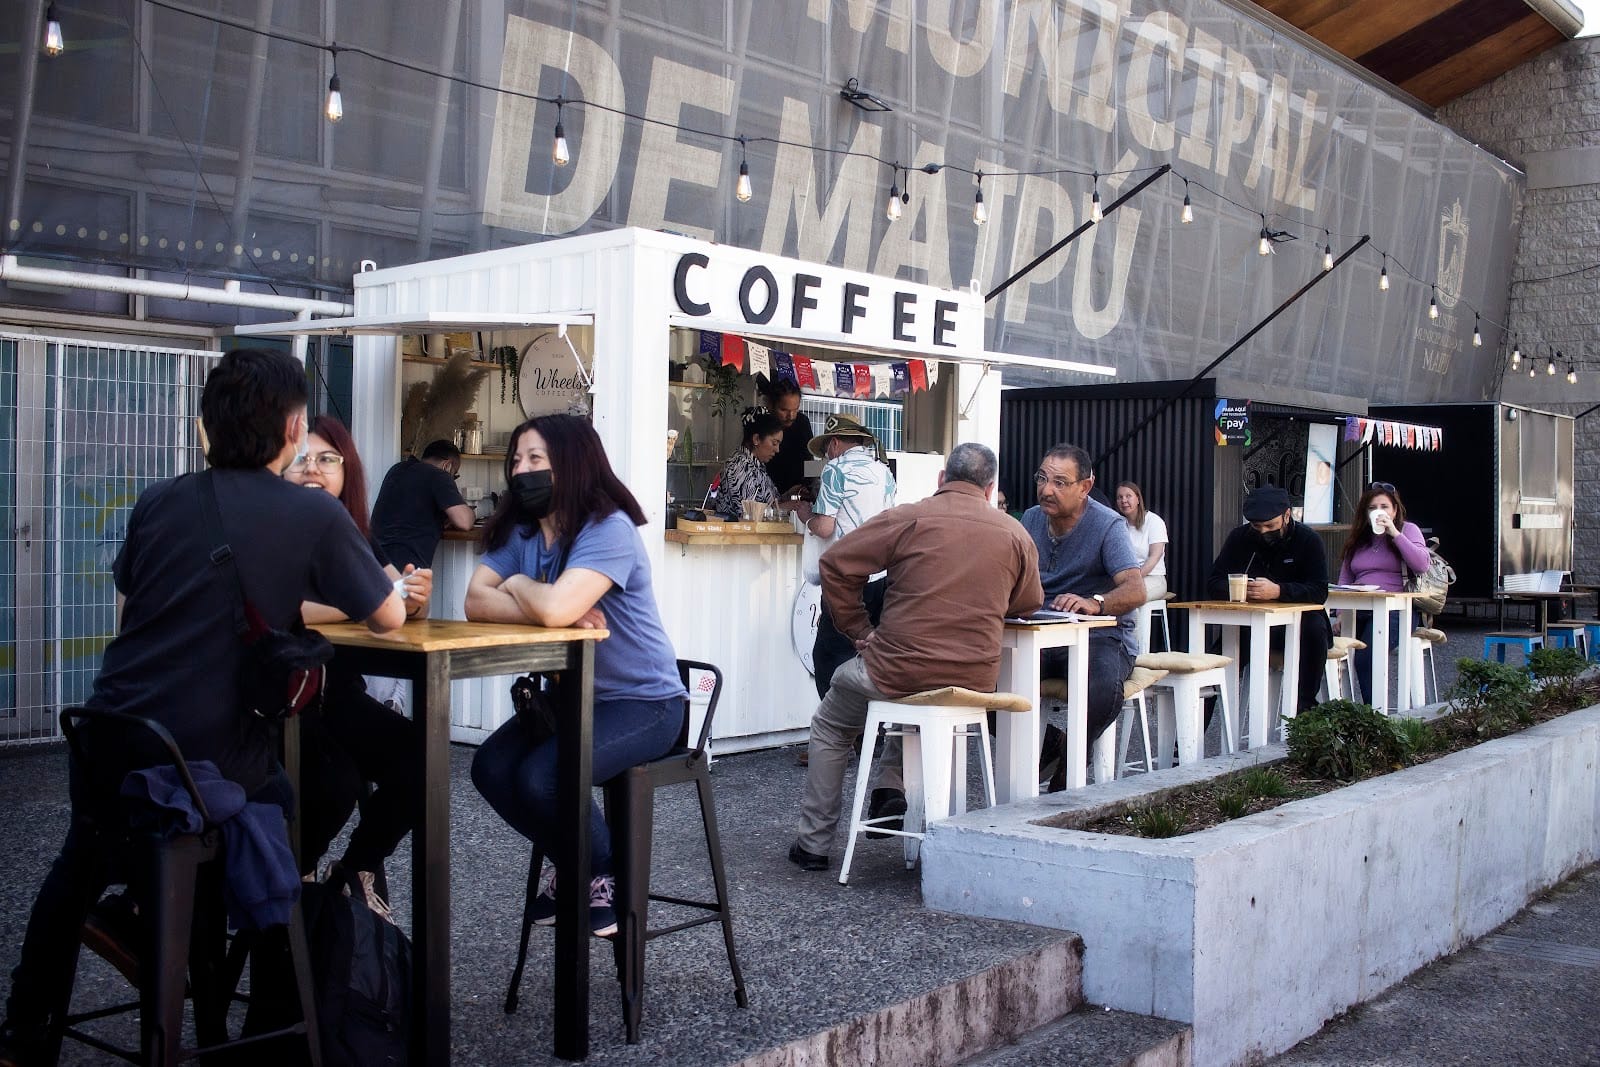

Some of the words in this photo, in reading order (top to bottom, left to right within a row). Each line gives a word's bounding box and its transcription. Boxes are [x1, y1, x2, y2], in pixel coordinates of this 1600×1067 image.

[482, 14, 736, 243] DE
[806, 0, 1317, 211] UNICIPAL
[673, 252, 959, 348] COFFEE
[534, 367, 582, 390] Wheels
[1219, 416, 1245, 430] Fpay
